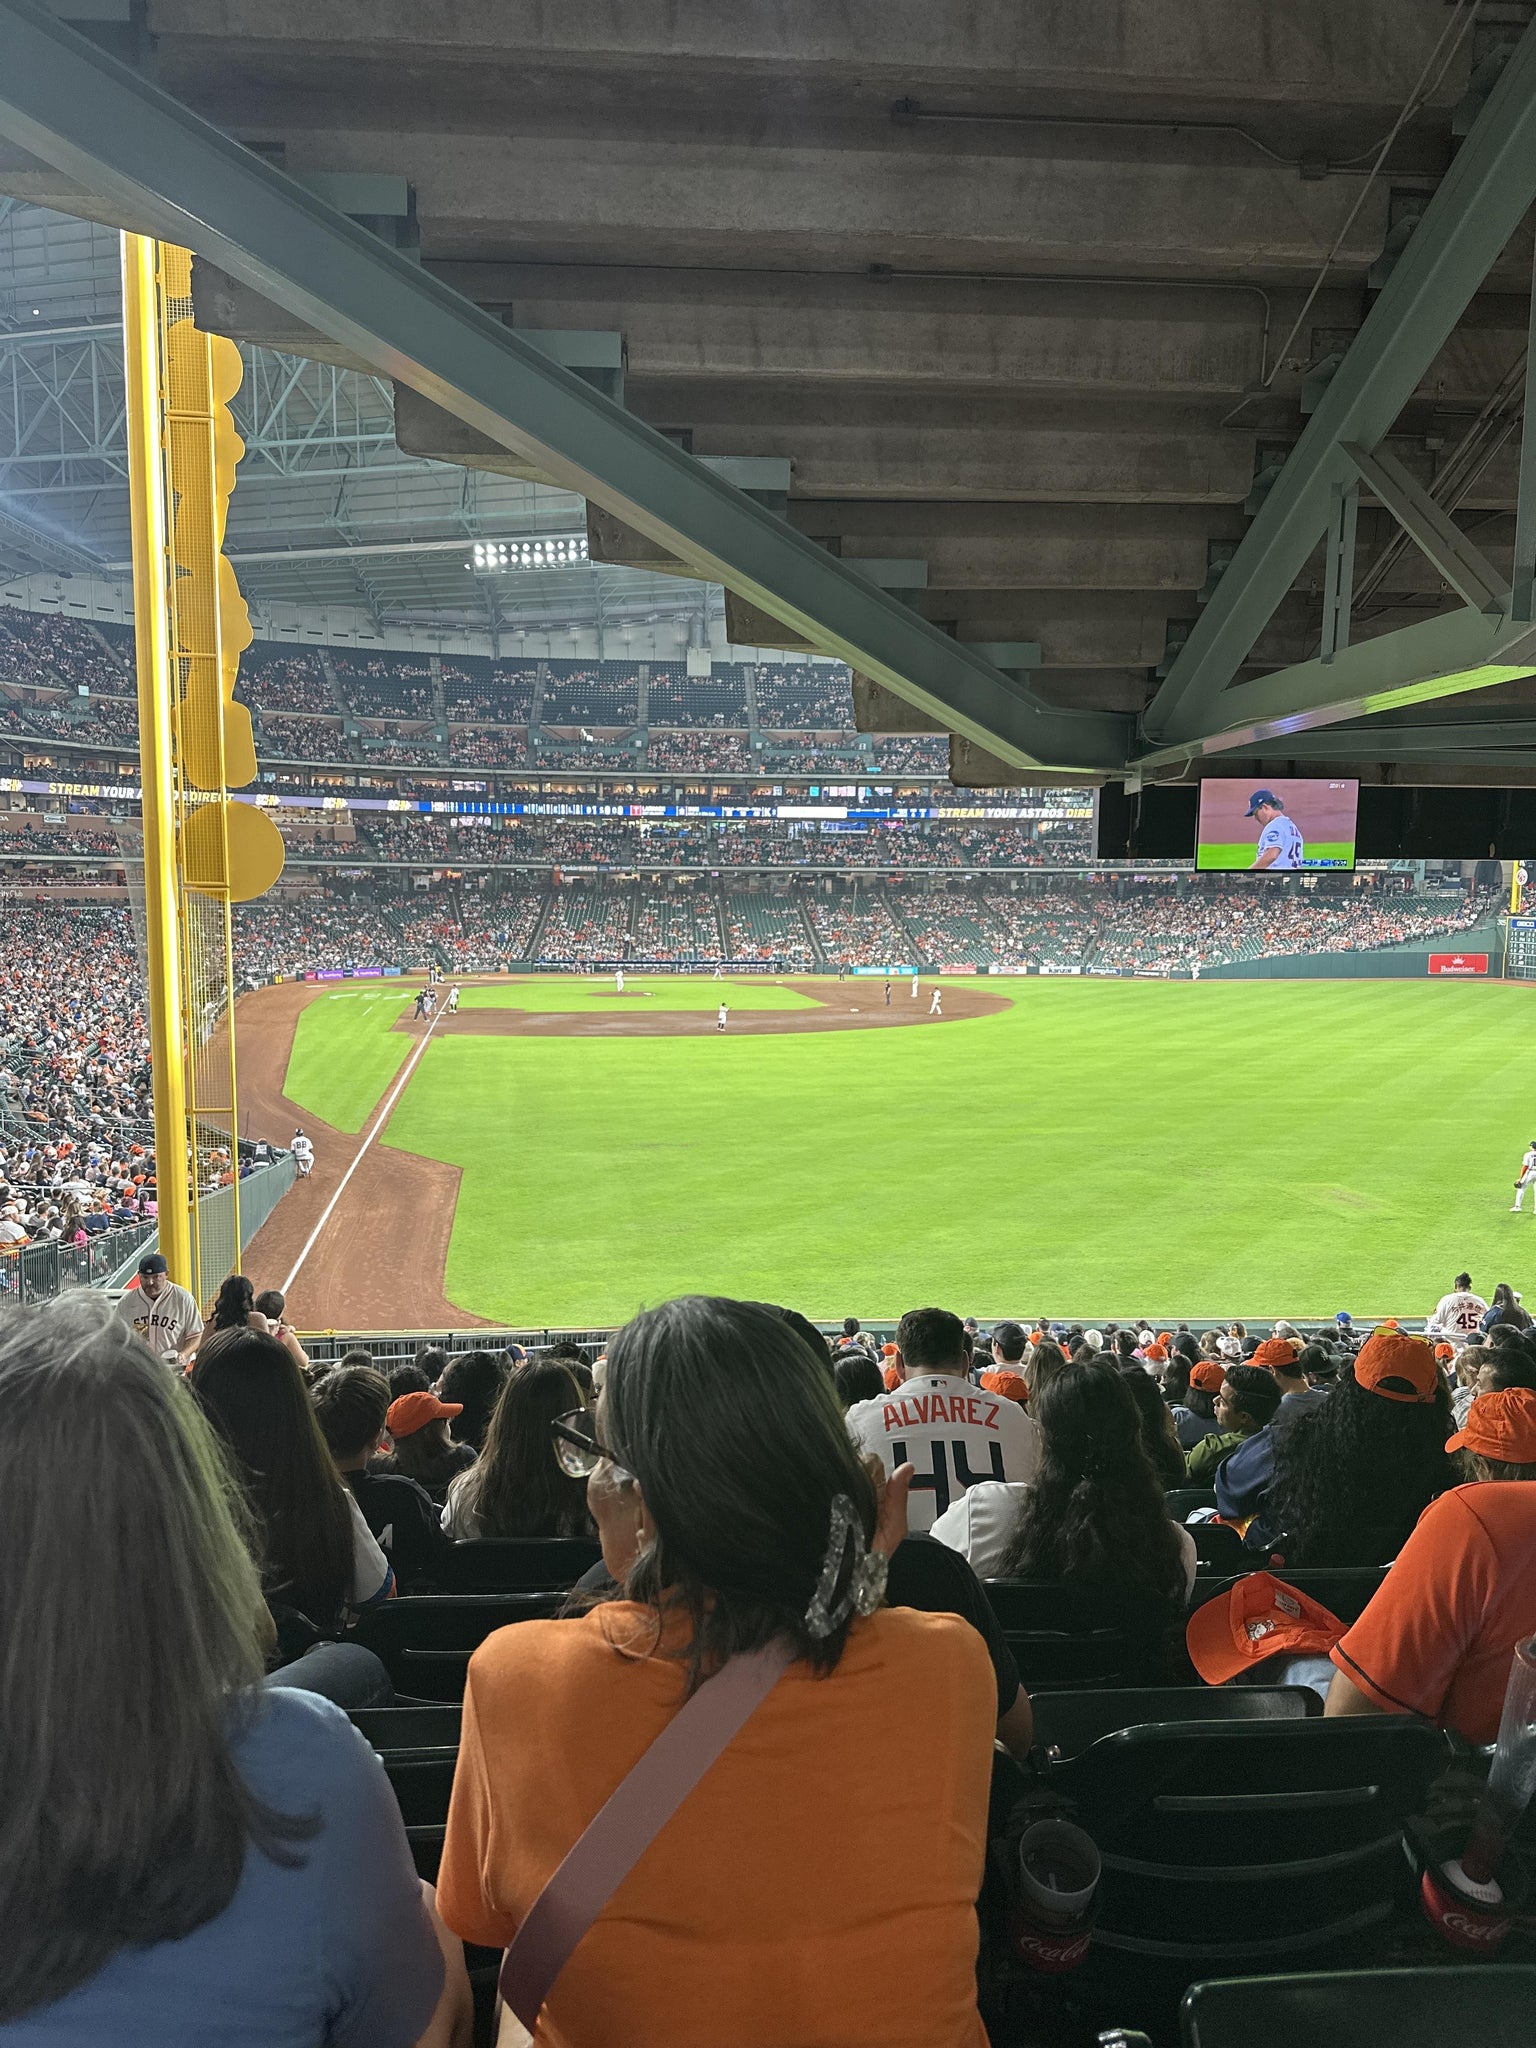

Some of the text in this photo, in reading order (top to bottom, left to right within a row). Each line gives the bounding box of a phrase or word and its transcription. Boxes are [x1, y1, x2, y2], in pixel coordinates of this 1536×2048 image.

[48, 783, 100, 796] STREAM
[102, 786, 135, 799] YOUR
[938, 808, 1093, 818] STREAM YOUR ASTROS DIRE
[1440, 965, 1475, 973] Budweiser
[133, 1314, 178, 1331] STROS
[1456, 1313, 1478, 1329] 45
[883, 1394, 1000, 1432] ALVAREZ
[892, 1440, 1006, 1533] 44
